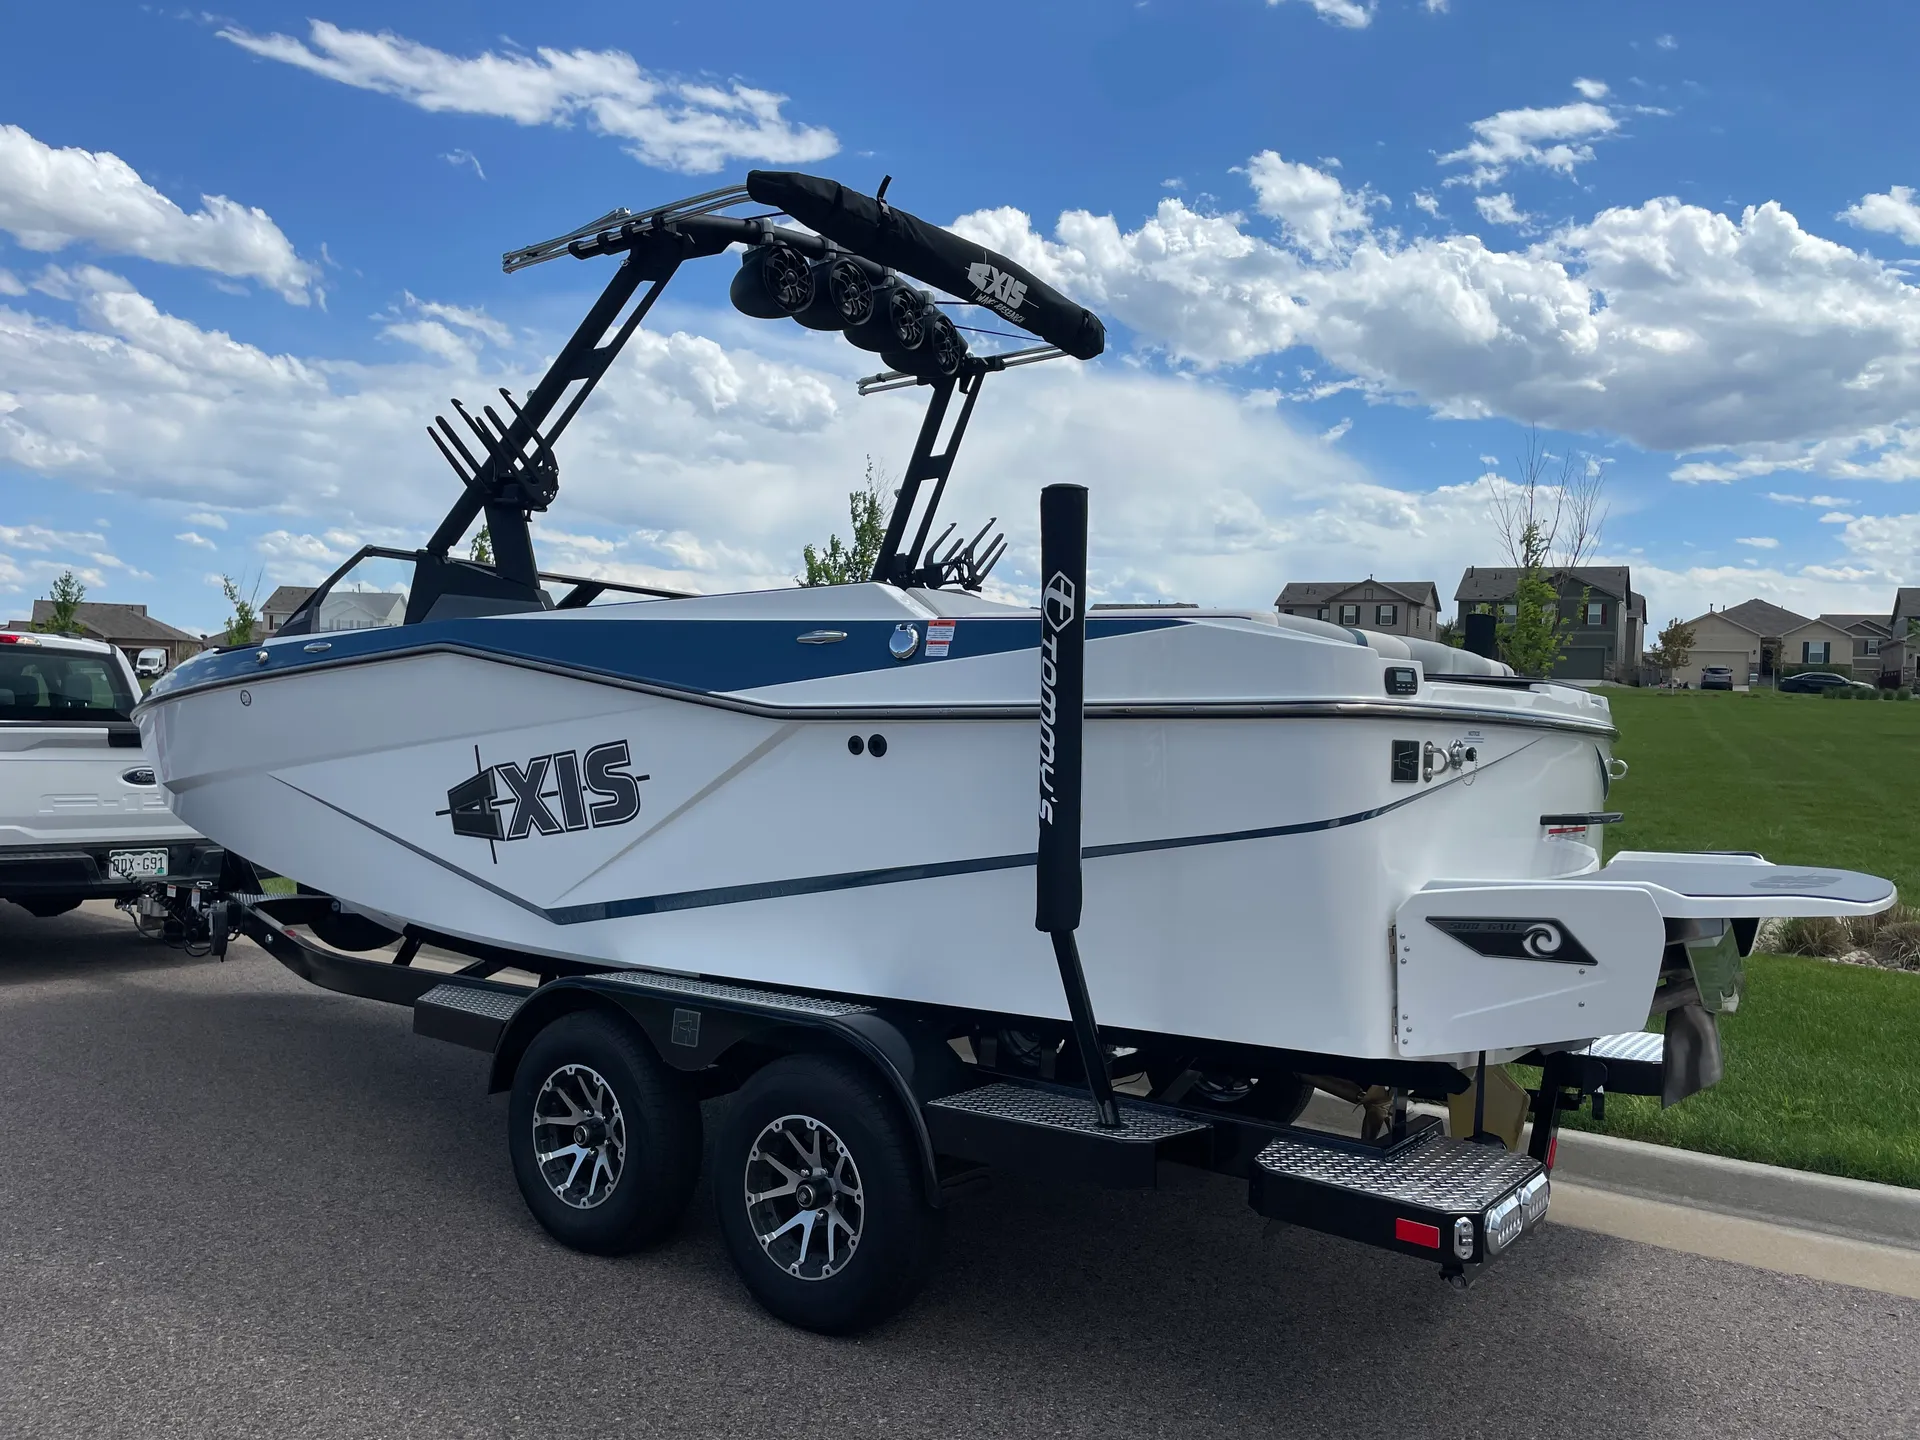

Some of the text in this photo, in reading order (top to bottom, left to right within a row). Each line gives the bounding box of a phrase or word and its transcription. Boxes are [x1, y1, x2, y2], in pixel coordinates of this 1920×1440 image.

[967, 262, 1028, 309] AXIS
[994, 303, 1026, 323] RESEARCH
[447, 739, 641, 842] AXIS
